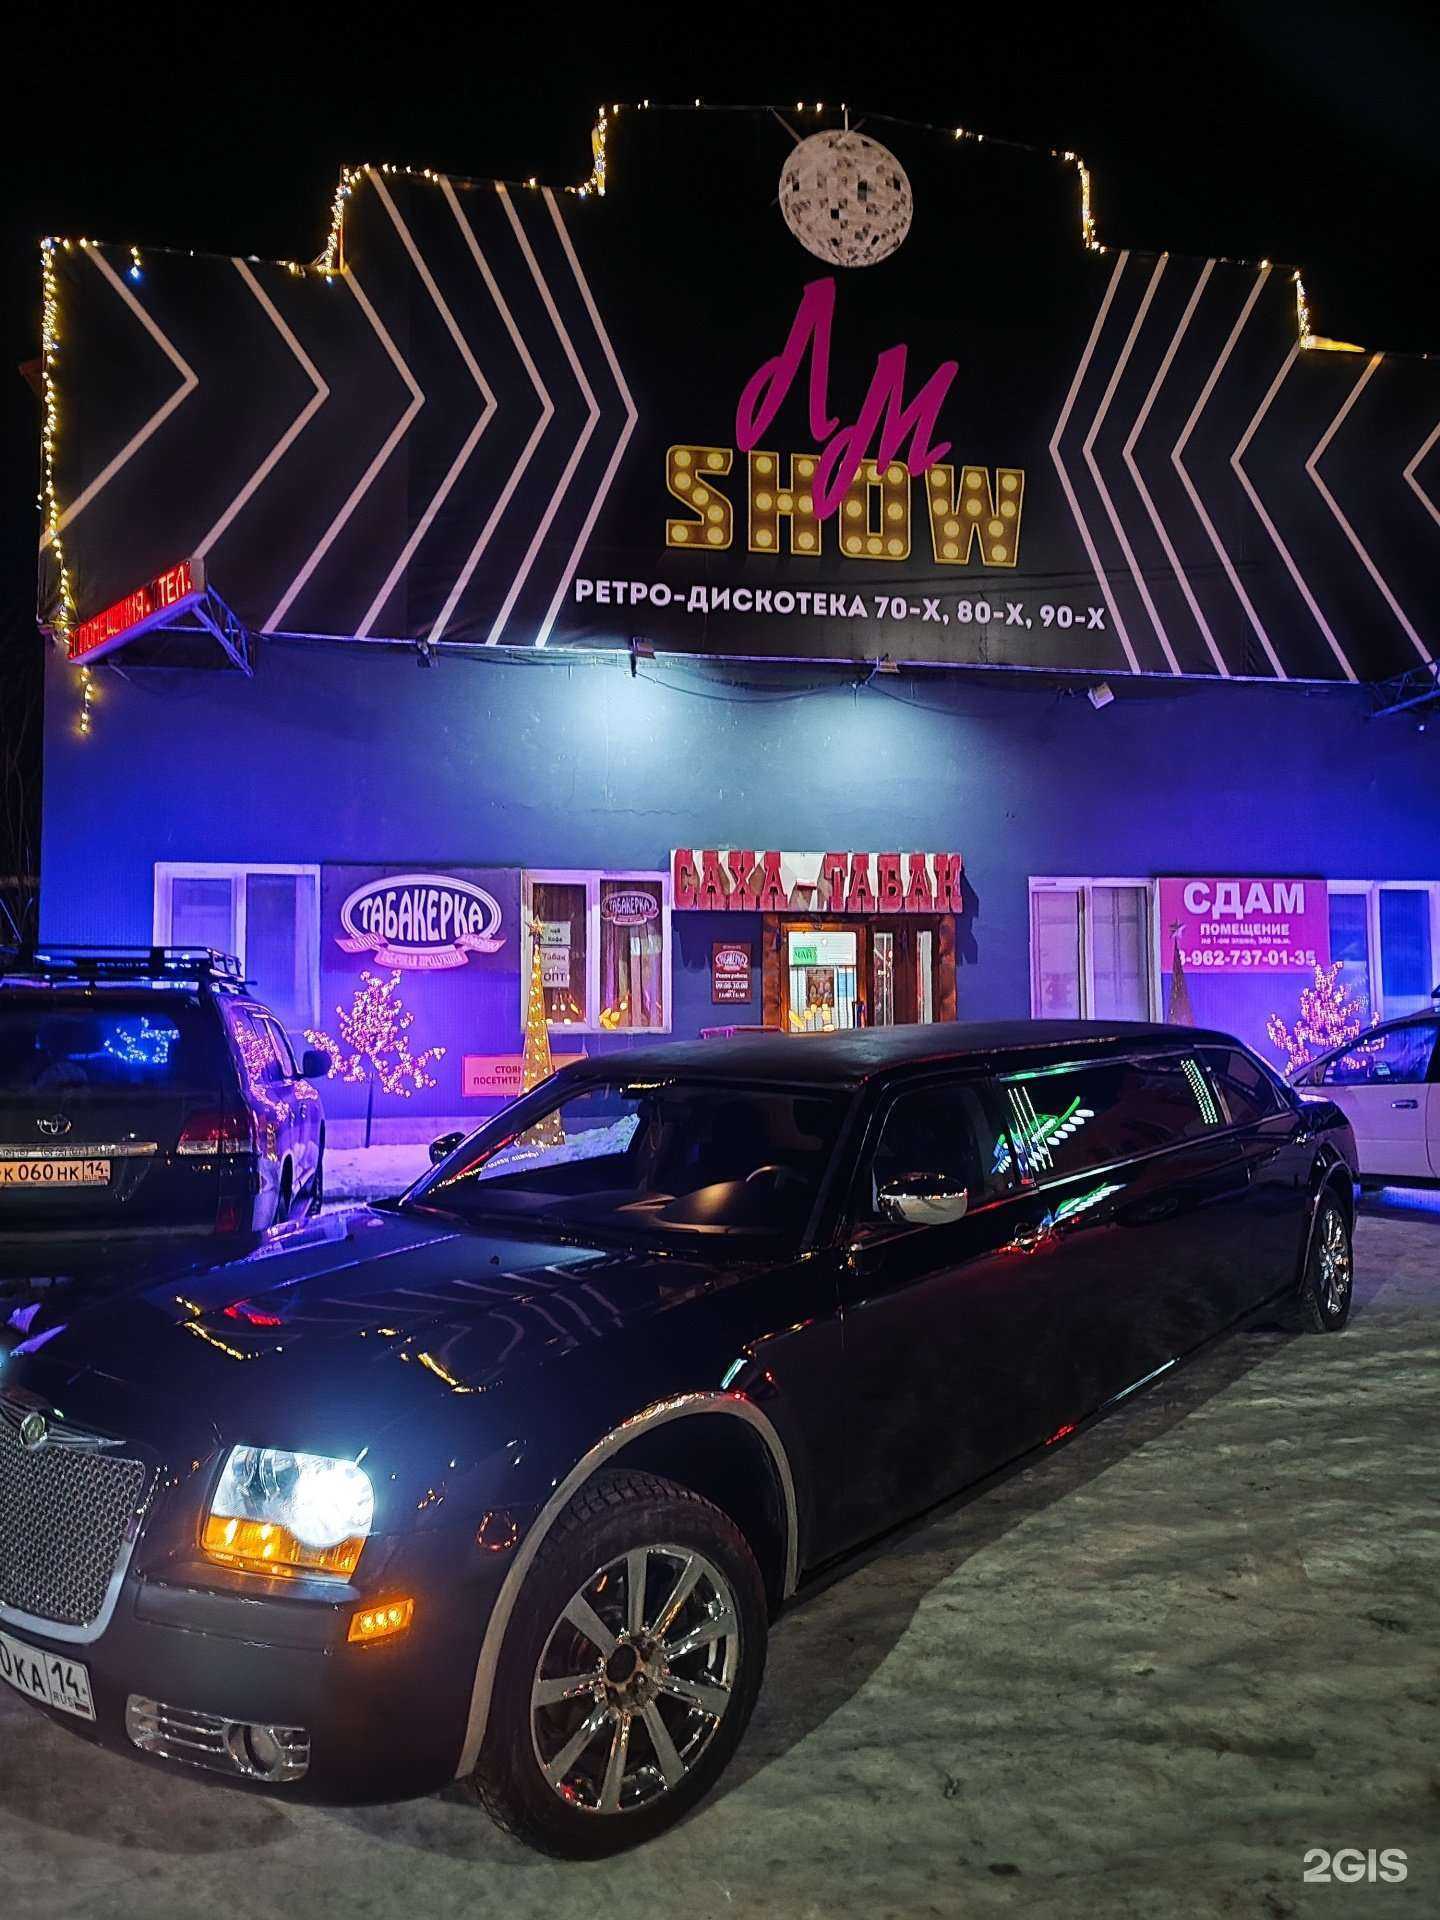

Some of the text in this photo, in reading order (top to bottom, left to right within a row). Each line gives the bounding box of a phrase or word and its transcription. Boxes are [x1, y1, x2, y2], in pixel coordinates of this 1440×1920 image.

[666, 445, 1025, 568] SHOW
[575, 578, 1105, 630] РЕТРО-ДИСКОТЕКА 70-Х, 80-Х, 90-Х
[359, 888, 484, 942] ТАБАКЕРКА
[1183, 881, 1305, 920] СДАМ
[1200, 923, 1290, 936] ПОМЕЩЕНИЕ
[51, 1661, 80, 1699] 14
